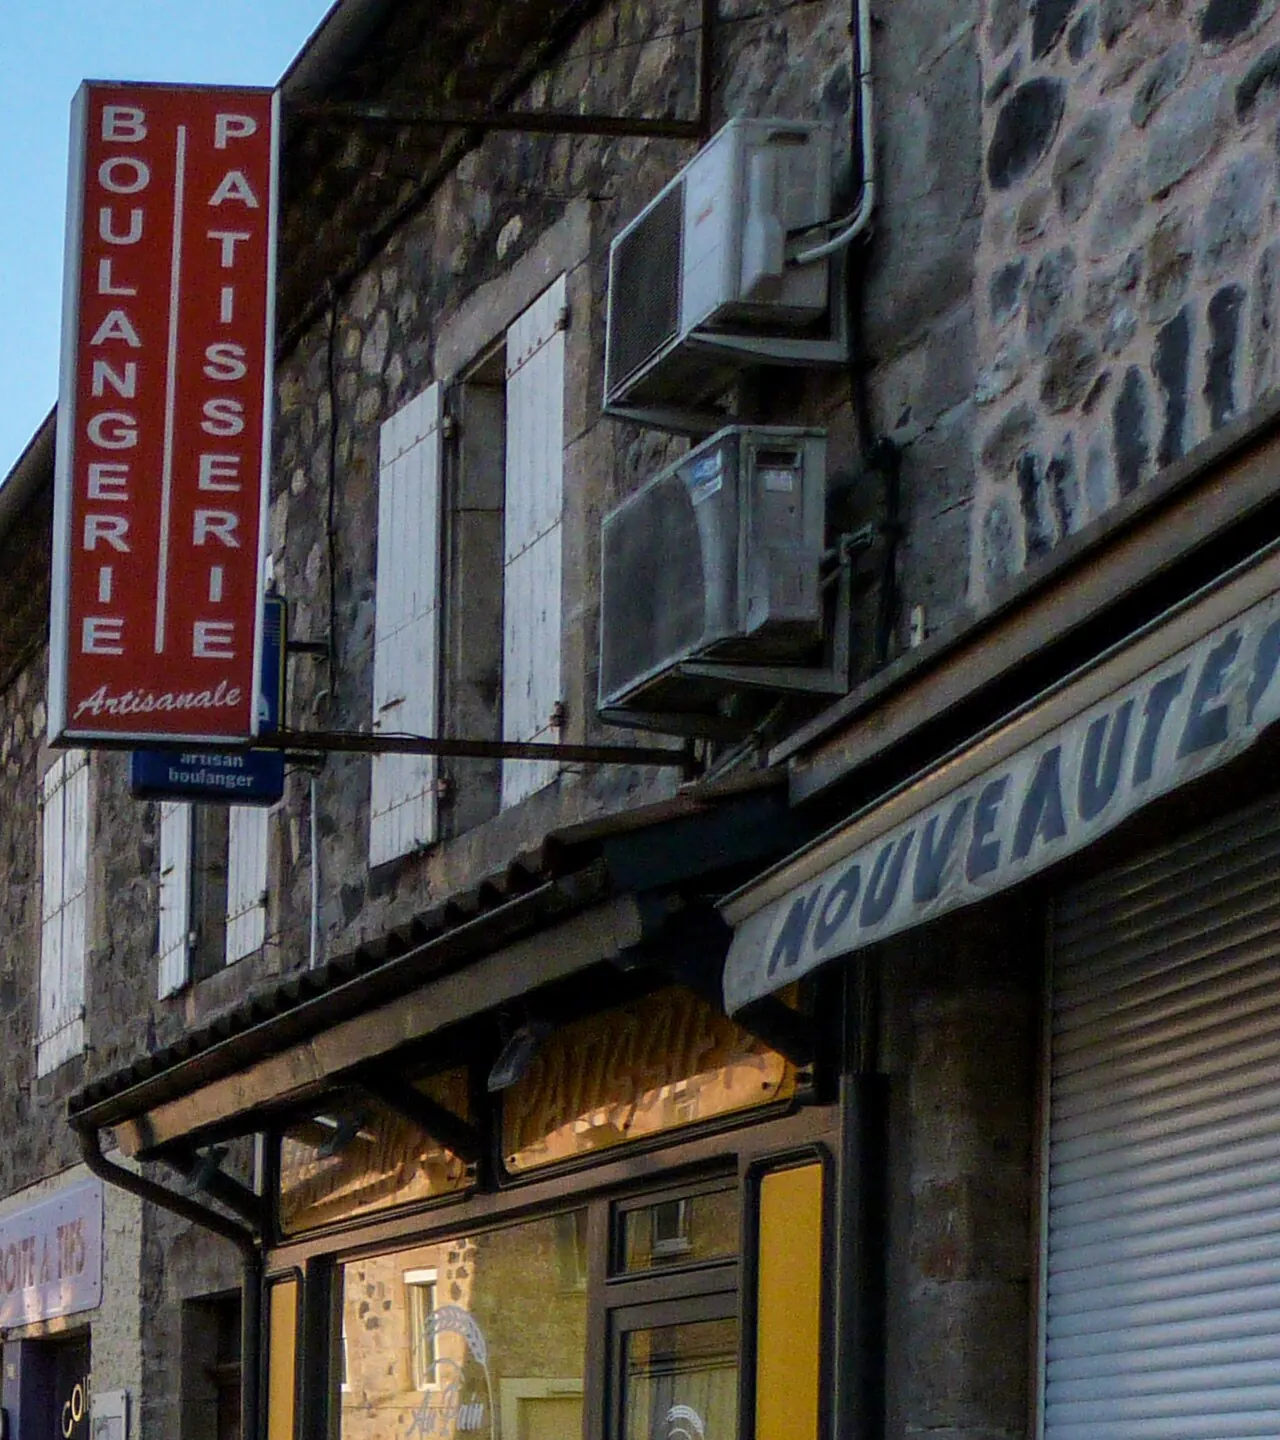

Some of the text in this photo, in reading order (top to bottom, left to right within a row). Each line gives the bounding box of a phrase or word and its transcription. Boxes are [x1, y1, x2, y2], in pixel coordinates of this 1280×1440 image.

[81, 104, 149, 656] BOULANGERIE
[192, 113, 260, 660] PATISSERIE
[73, 679, 241, 720] Artisanale
[168, 767, 255, 789] boulanger
